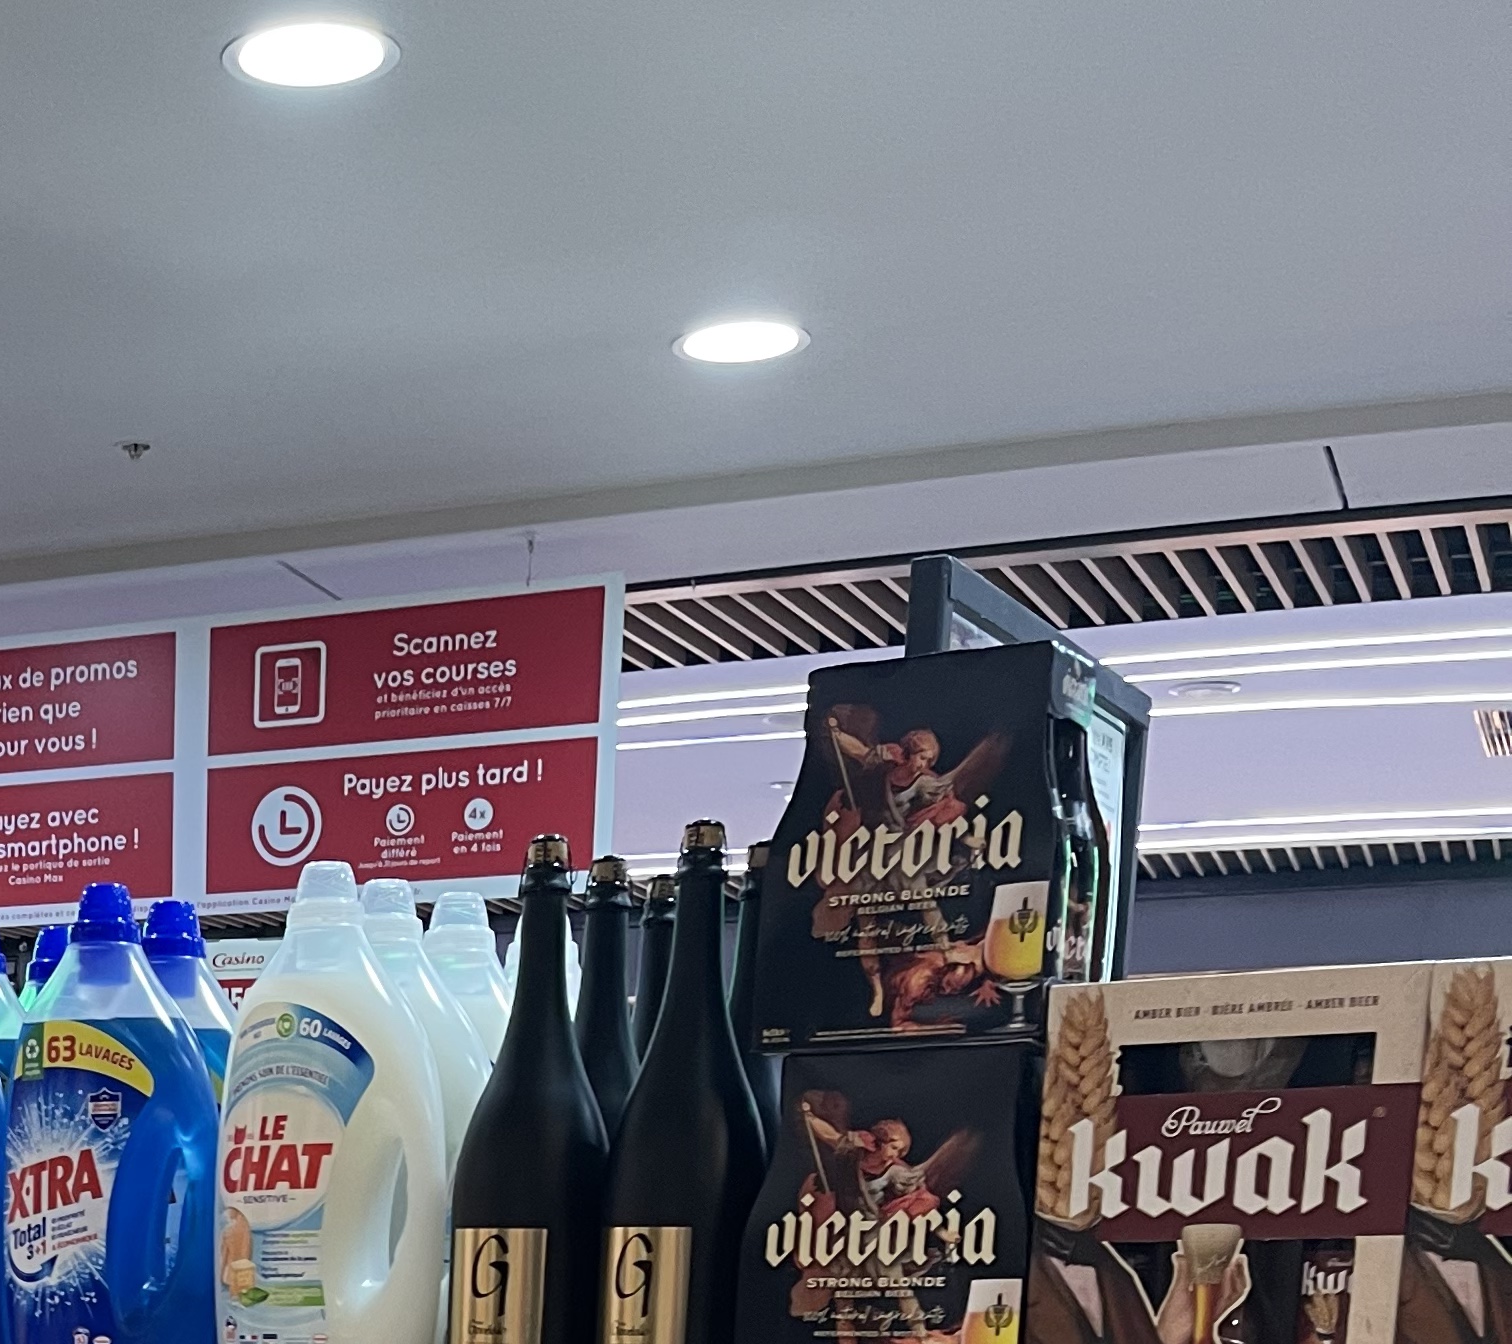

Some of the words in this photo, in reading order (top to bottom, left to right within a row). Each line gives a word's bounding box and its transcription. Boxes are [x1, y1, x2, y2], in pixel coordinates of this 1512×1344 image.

[393, 630, 497, 657] Scannez
[18, 663, 46, 689] de
[49, 657, 139, 692] promos
[374, 669, 414, 689] vos
[421, 659, 517, 684] courses
[38, 698, 83, 726] que
[374, 704, 431, 721] prioritaire
[433, 704, 448, 714] en
[450, 700, 490, 712] caisses
[494, 696, 512, 709] 7/7
[377, 695, 387, 704] et
[33, 731, 85, 755] vous
[90, 728, 98, 750] !
[343, 773, 413, 799] Payez
[421, 766, 470, 796] plus
[477, 759, 529, 786] tard
[536, 758, 543, 782] !
[47, 807, 99, 827] avec
[468, 807, 486, 820] 4x
[133, 828, 139, 849] !
[373, 834, 425, 848] Paiement
[451, 829, 504, 843] Paiement
[453, 845, 468, 854] en
[470, 844, 478, 853] 4
[481, 843, 501, 853] fois
[787, 795, 1024, 889] victoria
[11, 862, 20, 872] le
[22, 860, 65, 873] portique
[66, 858, 79, 868] de
[82, 856, 111, 867] sortie
[8, 875, 41, 886] Casino
[43, 874, 63, 884] Max
[829, 890, 894, 908] STRONG
[901, 884, 970, 902] BLONDE
[212, 951, 265, 969] Casino
[1305, 997, 1344, 1010] AMBER
[299, 1018, 321, 1039] 60
[47, 1035, 76, 1063] 63
[79, 1042, 135, 1071] LAVAGES
[259, 1115, 288, 1141] LE
[1161, 1097, 1281, 1138] Pauwel
[223, 1142, 333, 1194] CHAT
[1068, 1107, 1367, 1219] kwak
[12, 1216, 47, 1250] Total
[764, 1188, 996, 1269] victoria
[806, 1277, 868, 1290] STRONG
[875, 1276, 946, 1289] BLONDE
